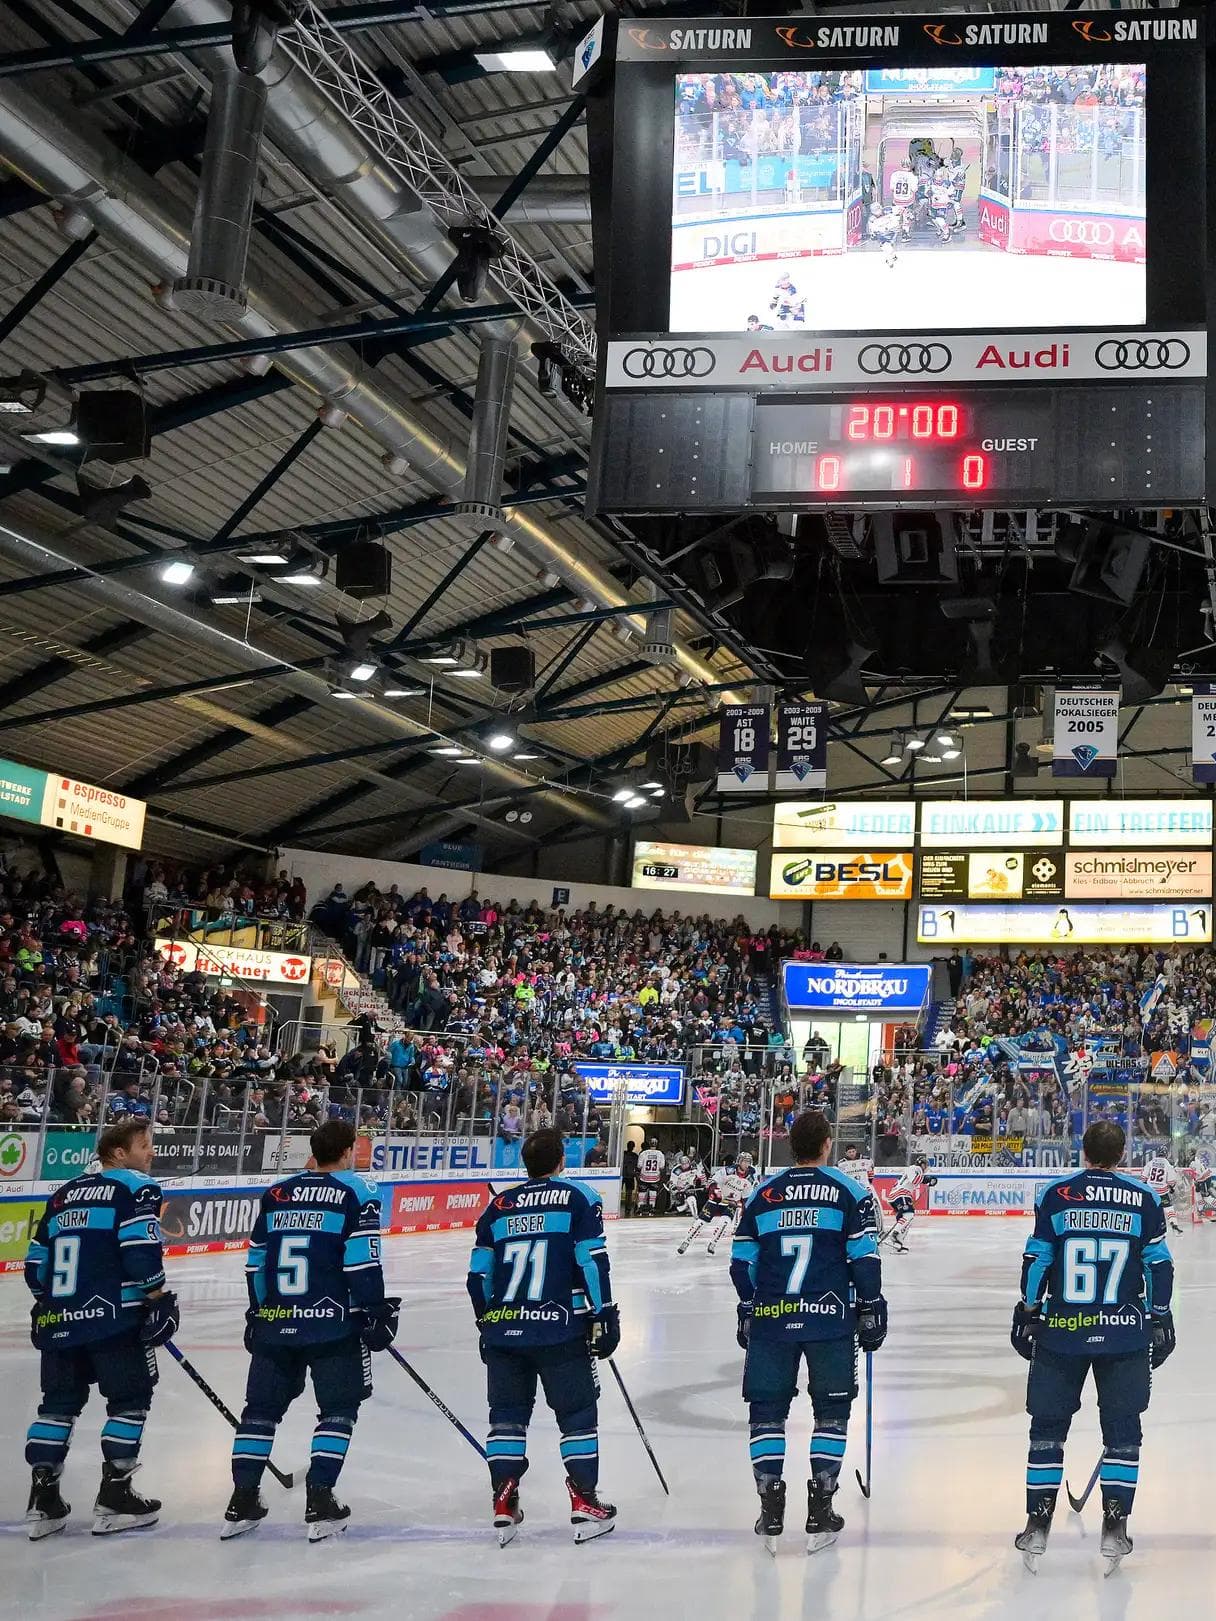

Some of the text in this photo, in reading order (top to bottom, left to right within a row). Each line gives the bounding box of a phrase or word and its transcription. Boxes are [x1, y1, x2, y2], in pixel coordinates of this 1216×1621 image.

[669, 28, 752, 50] SATURN
[816, 26, 900, 48] SATURN
[964, 23, 1048, 46] SATURN
[1113, 19, 1198, 42] SATURN
[980, 206, 1009, 235] Audi
[703, 232, 757, 259] DIGI
[739, 348, 833, 374] Audi
[975, 343, 1070, 370] Audi
[769, 442, 818, 455] HOME
[981, 438, 1039, 452] GUEST
[818, 457, 840, 489] 0
[962, 455, 984, 488] 0
[1059, 697, 1114, 706] DEUTSCHER
[736, 718, 753, 728] AST
[790, 716, 816, 726] WAITE
[1055, 708, 1118, 718] POKALSIEGER
[1067, 720, 1105, 734] 2005
[733, 728, 756, 753] 18
[787, 726, 817, 751] 29
[73, 783, 126, 810] espresso
[70, 802, 131, 831] MedienGruppe
[846, 813, 912, 835] JEDER
[930, 811, 1029, 834] EINKAUF
[1074, 811, 1111, 833] EIN
[815, 863, 904, 882] BESL
[1073, 857, 1197, 879] schmidmeyer
[1072, 877, 1087, 885] Kies
[1092, 877, 1119, 885] Erdbau
[1123, 877, 1154, 885] Abbruch
[195, 958, 271, 977] Hackner
[807, 977, 909, 998] NORDBRÄU
[833, 998, 883, 1006] INGOLSTADT
[183, 1144, 205, 1157] THS
[206, 1144, 216, 1157] IS
[372, 1144, 488, 1171] STIEFEL
[645, 1160, 658, 1171] 93
[64, 1185, 116, 1204] SATURN
[291, 1186, 347, 1205] SATURN
[785, 1184, 840, 1203] SATURN
[987, 1181, 1026, 1190] Personal
[1085, 1185, 1143, 1207] SATURN
[399, 1193, 481, 1213] PENNY. PENNY.
[515, 1189, 571, 1208] SATURN
[272, 1211, 325, 1230] WAGNER
[507, 1214, 545, 1235] FESER
[778, 1209, 820, 1228] JOBKE
[1063, 1211, 1132, 1233] FRIEDRICH
[52, 1235, 81, 1298] 9
[277, 1235, 311, 1296] 5
[501, 1239, 549, 1303] 71
[780, 1234, 814, 1295] 7
[1063, 1237, 1130, 1304] 67
[754, 1298, 837, 1319] zieglerhaus
[1048, 1311, 1137, 1331] zieglerhaus
